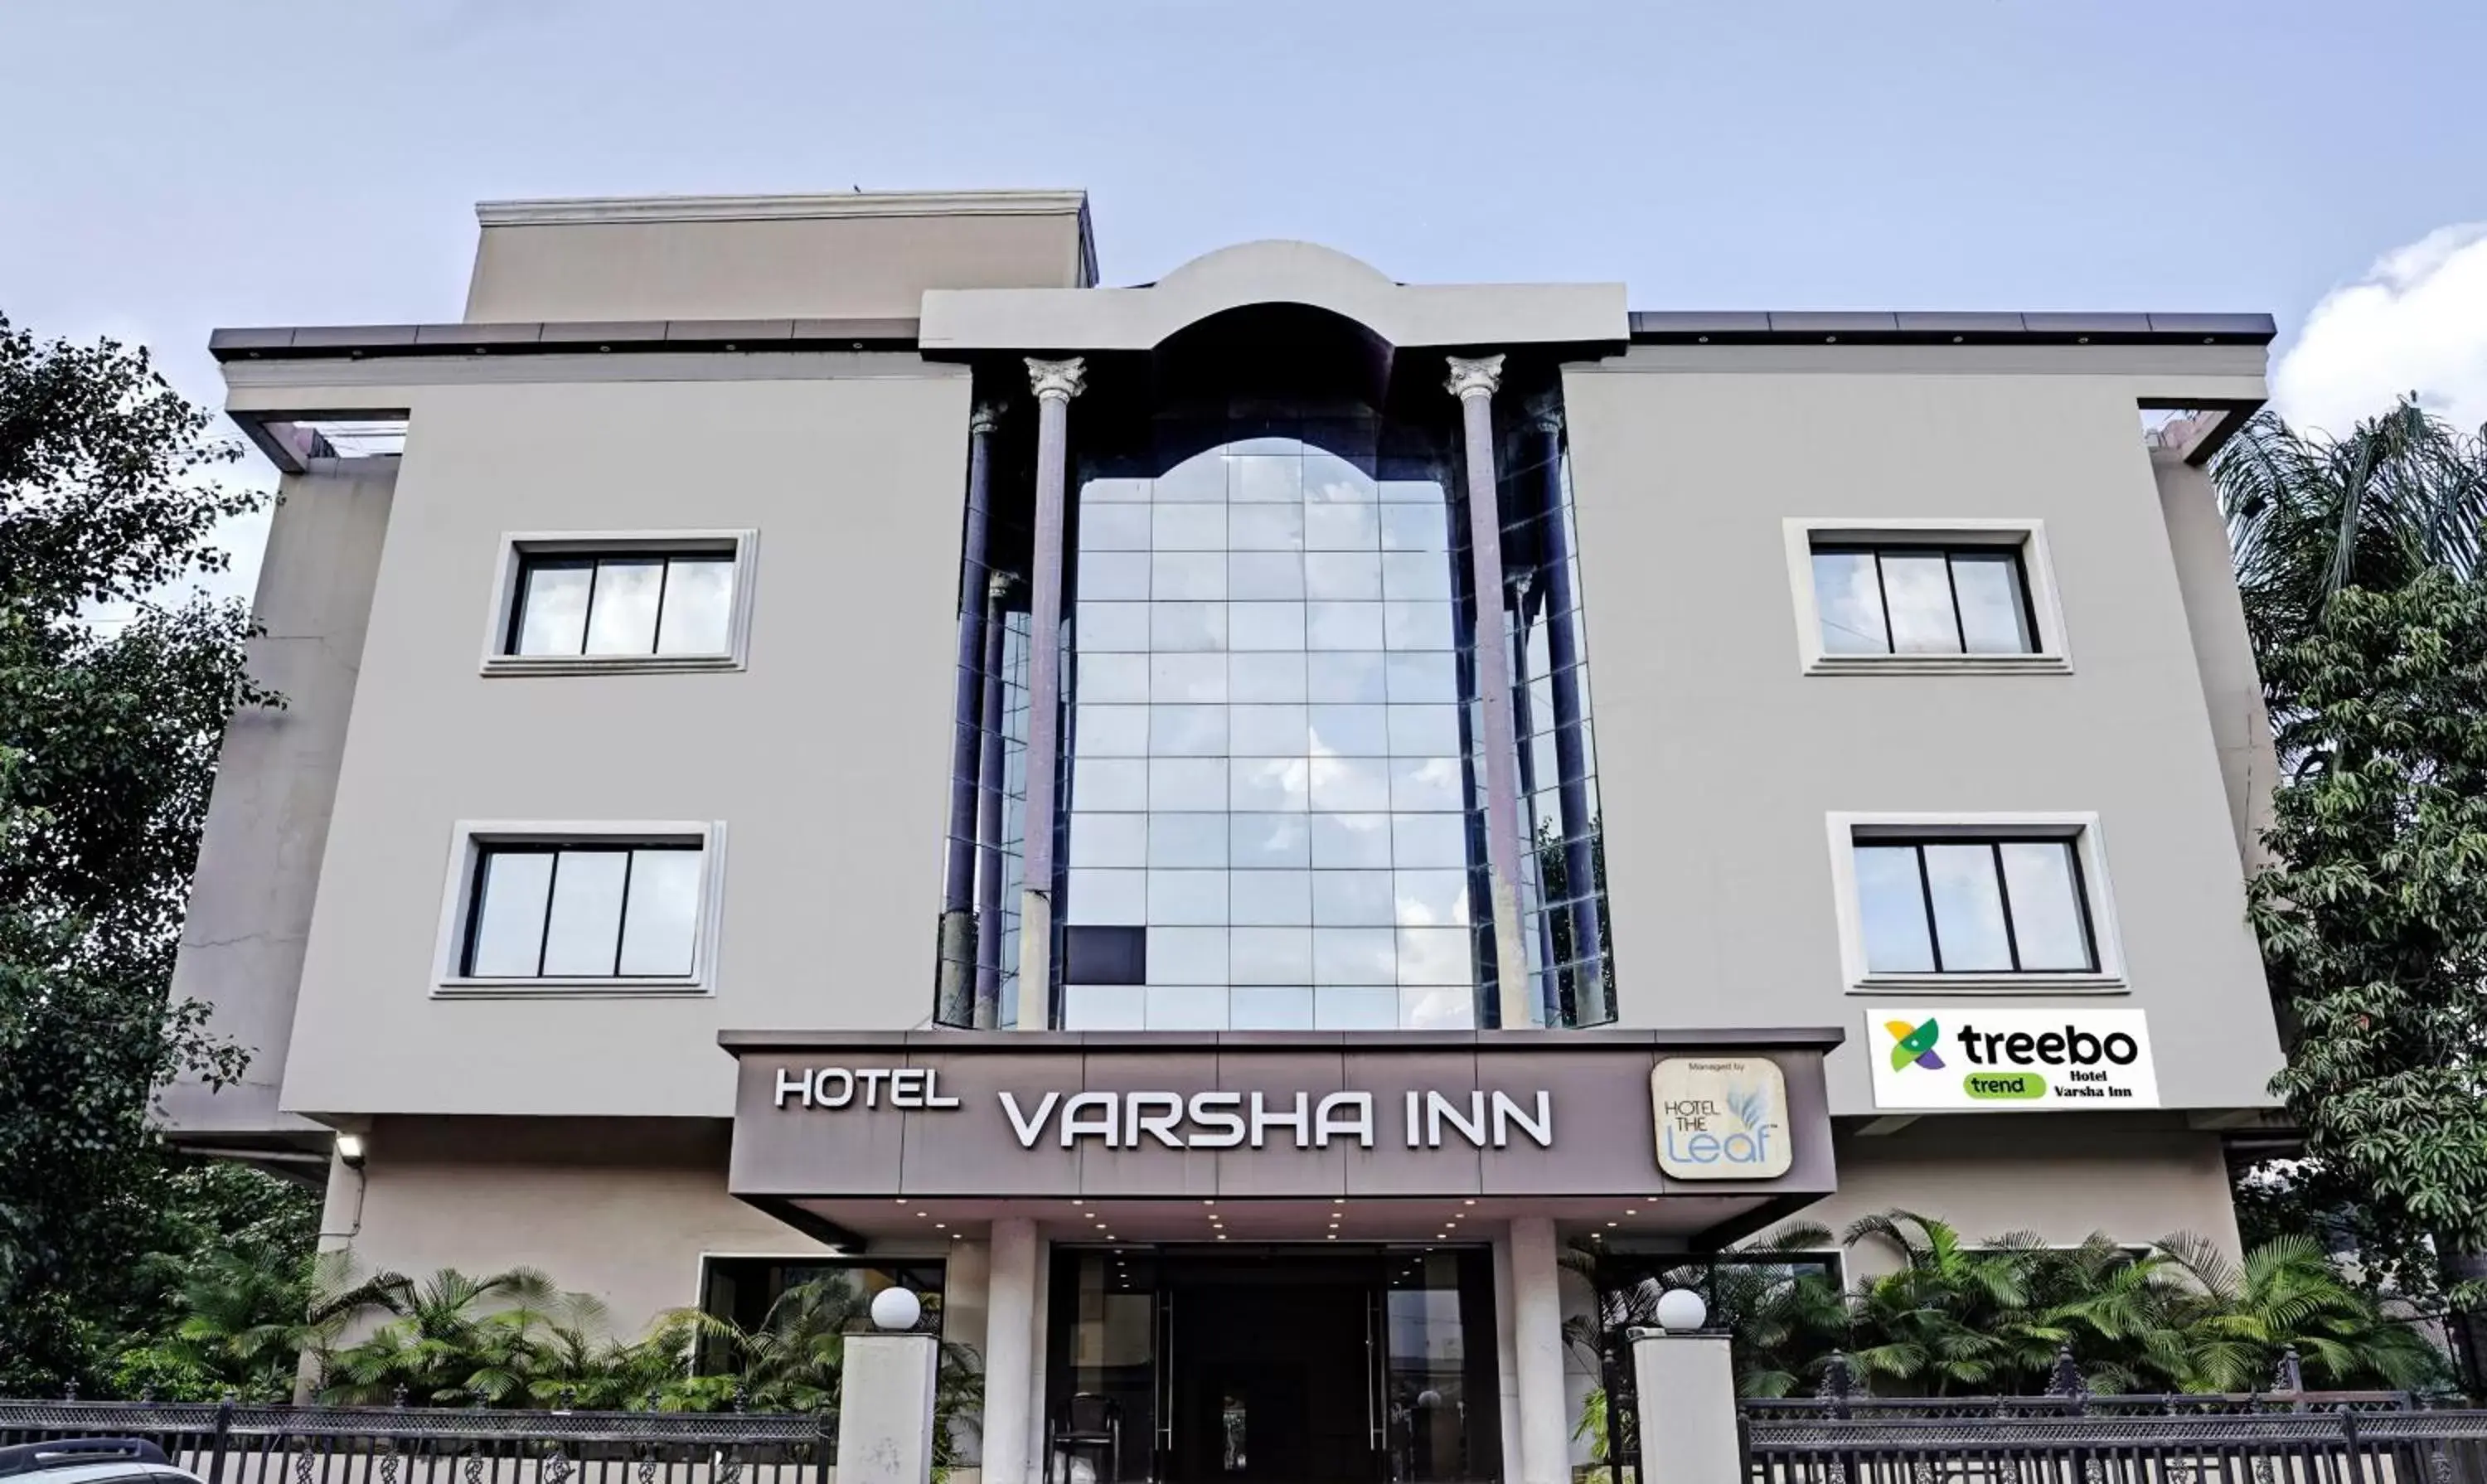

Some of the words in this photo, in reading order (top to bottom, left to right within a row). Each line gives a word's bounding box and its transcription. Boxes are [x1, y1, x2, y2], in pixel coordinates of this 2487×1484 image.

[1957, 1026, 2138, 1065] treebo
[1689, 1062, 1732, 1071] Managed
[1733, 1062, 1745, 1071] by
[2070, 1070, 2108, 1083] Hotel
[1971, 1077, 2025, 1094] trend
[2055, 1086, 2105, 1098] Varsha
[2109, 1086, 2132, 1098] Inn
[774, 1068, 960, 1108] HOTEL
[999, 1092, 1374, 1147] VARSHA
[1405, 1090, 1552, 1147] INN
[1665, 1100, 1720, 1116] HOTEL
[1676, 1117, 1707, 1132] THE
[1666, 1124, 1771, 1163] Leaf
